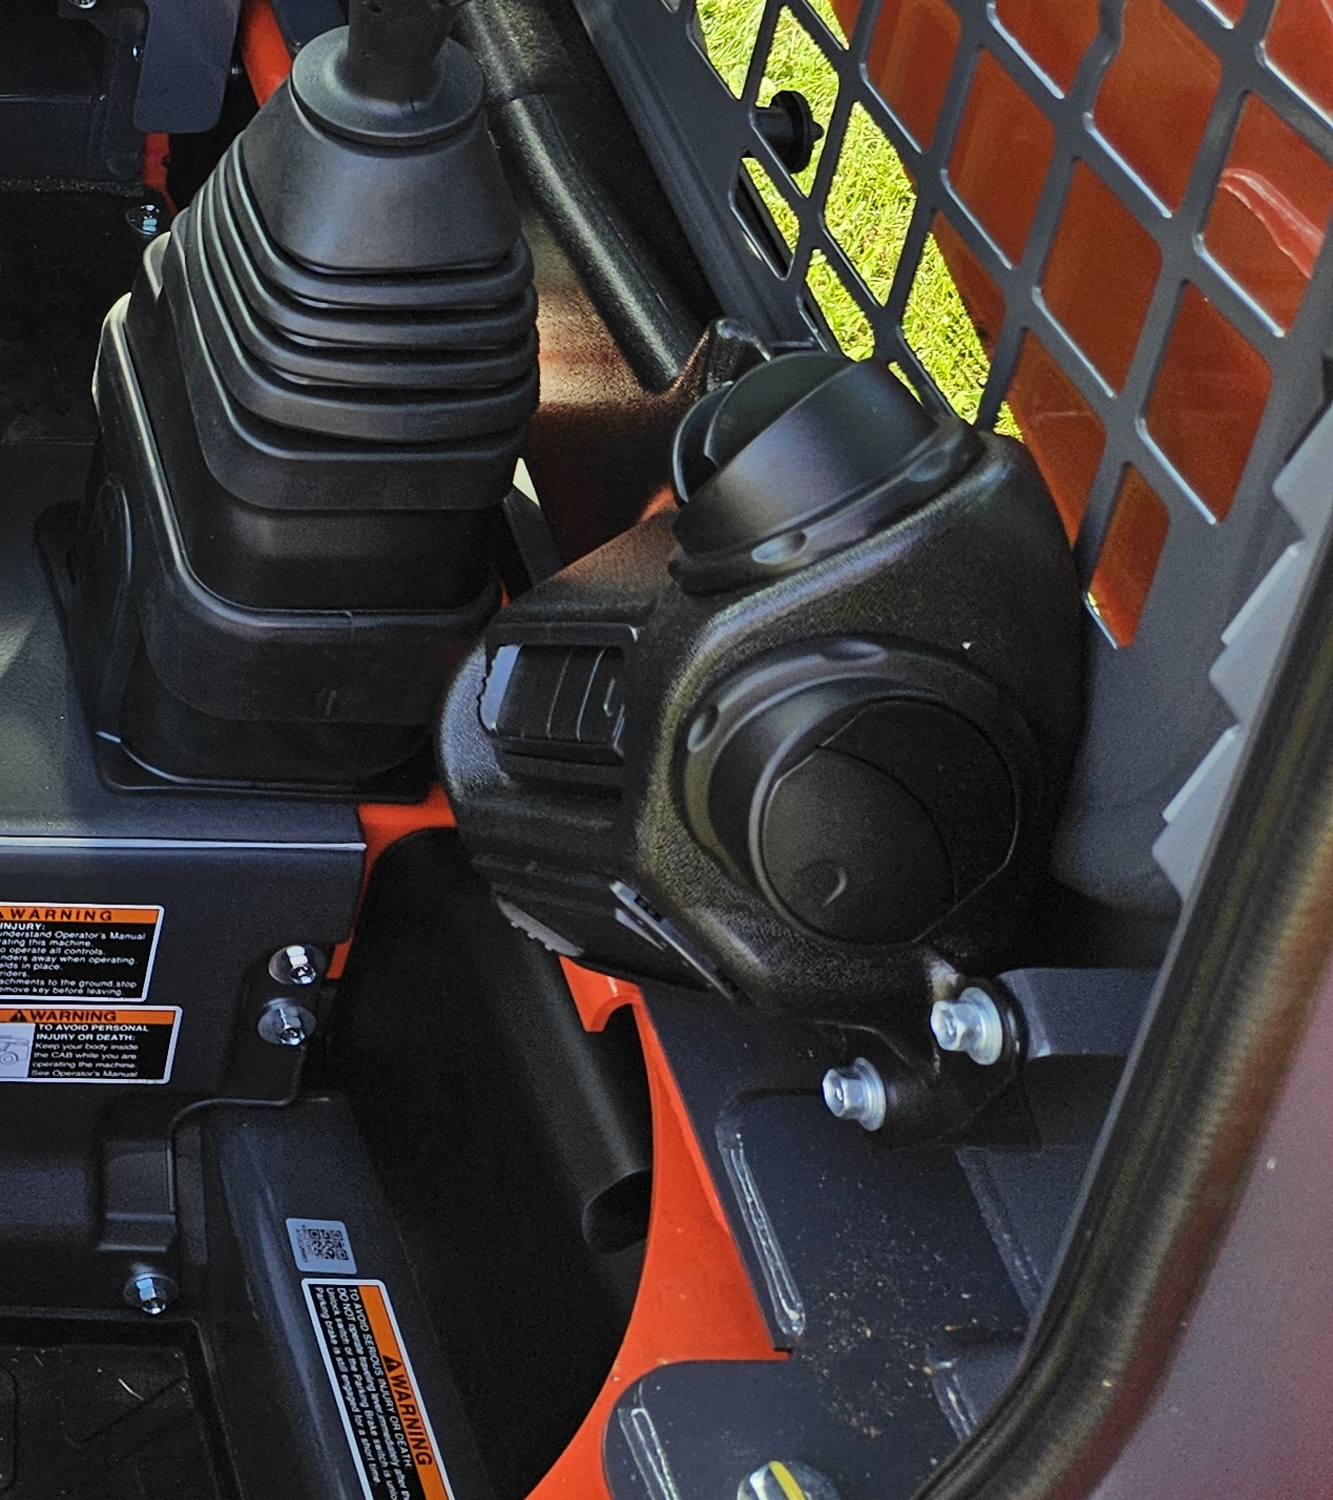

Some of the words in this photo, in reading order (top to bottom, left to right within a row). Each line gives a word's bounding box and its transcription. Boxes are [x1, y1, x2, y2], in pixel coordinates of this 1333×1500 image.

[10, 908, 112, 921] WARNING
[0, 922, 46, 931] INJURY:
[55, 931, 106, 939] Operator's
[109, 932, 146, 940] Manual
[9, 947, 46, 955] operate
[64, 948, 105, 956] controls.
[31, 956, 57, 964] away
[88, 957, 137, 966] operating.
[33, 963, 63, 971] place.
[32, 987, 50, 995] key
[86, 988, 125, 996] leaving.
[29, 1011, 116, 1021] WARNING
[85, 1043, 108, 1051] body
[349, 1289, 359, 1301] TO
[337, 1288, 349, 1301] DO
[343, 1303, 356, 1322] NOT
[353, 1303, 369, 1331] AVOID
[363, 1334, 384, 1376] SERIOUS
[378, 1379, 396, 1413] INJURY
[389, 1416, 401, 1431] OR
[390, 1374, 433, 1465] WARNING
